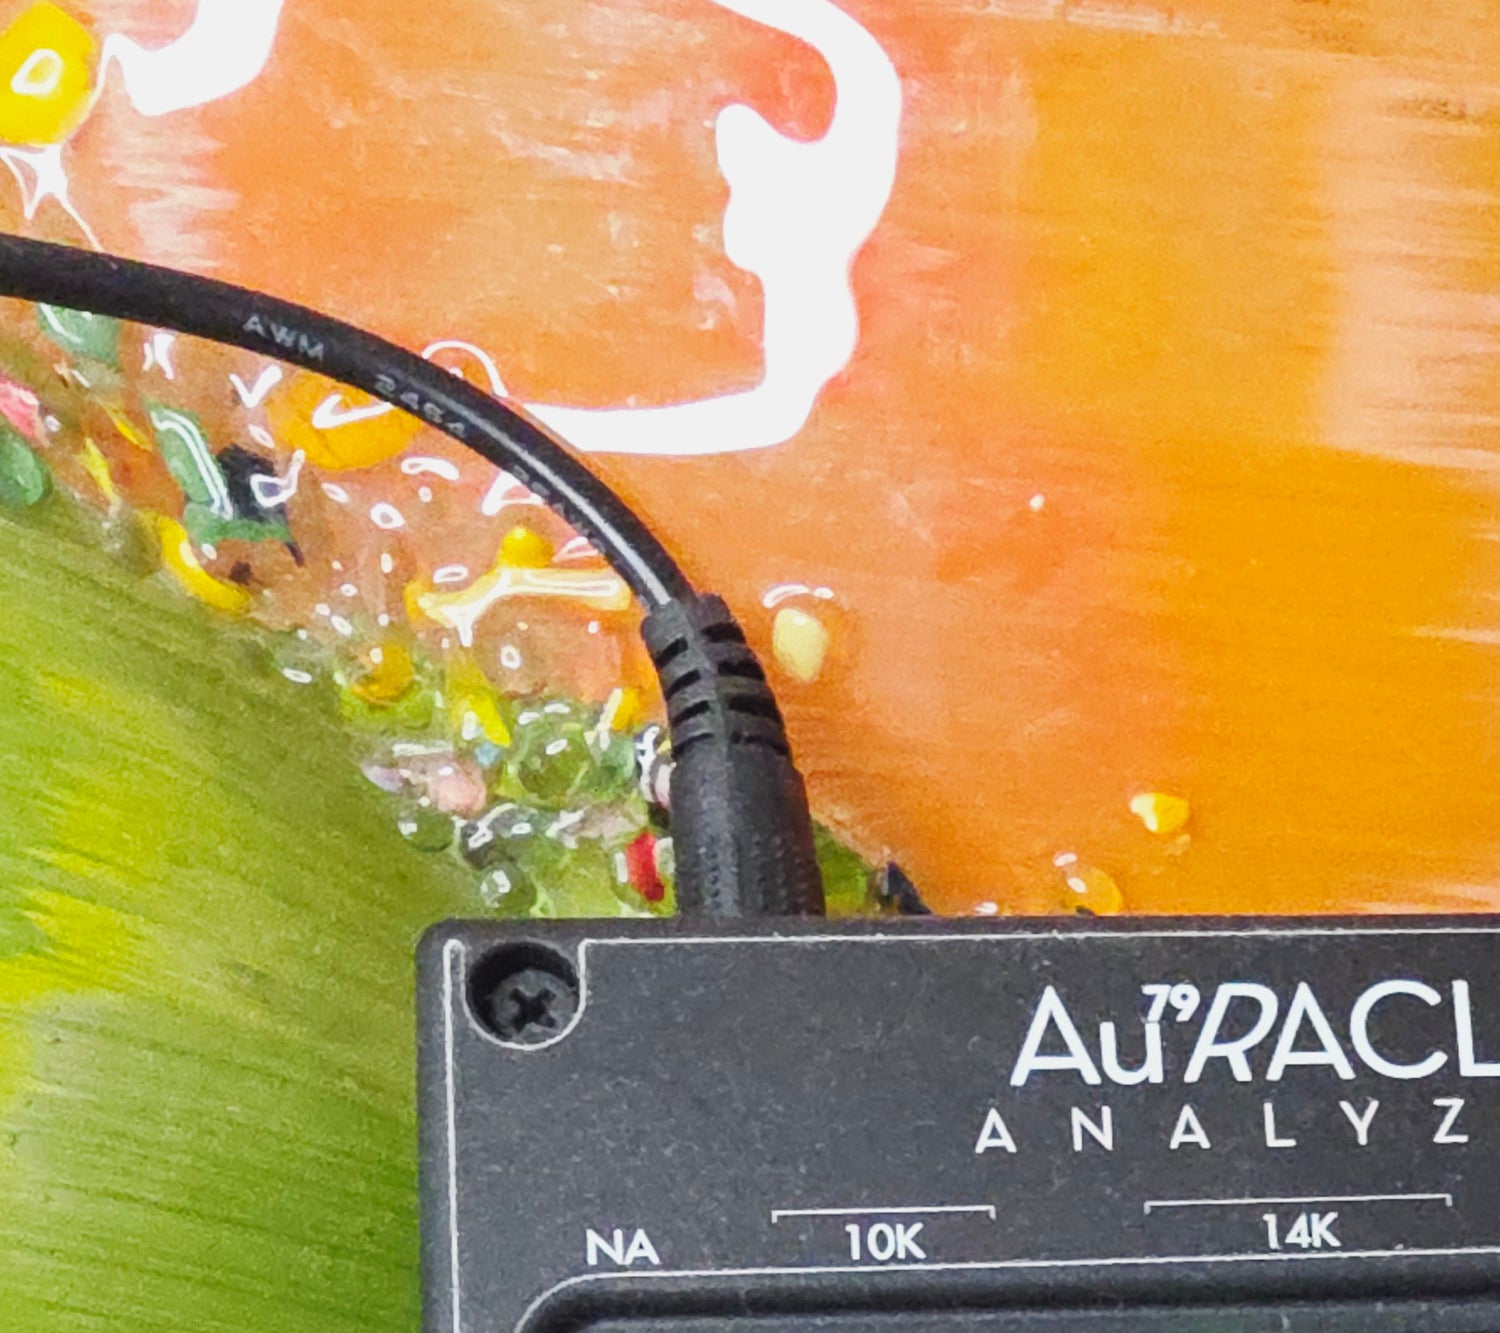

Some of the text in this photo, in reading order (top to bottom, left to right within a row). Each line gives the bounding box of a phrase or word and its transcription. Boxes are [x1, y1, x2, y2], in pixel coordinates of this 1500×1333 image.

[242, 314, 325, 361] AWM
[584, 1228, 661, 1266] NA
[844, 1222, 927, 1262] 10K
[1262, 1211, 1341, 1251] 14K
